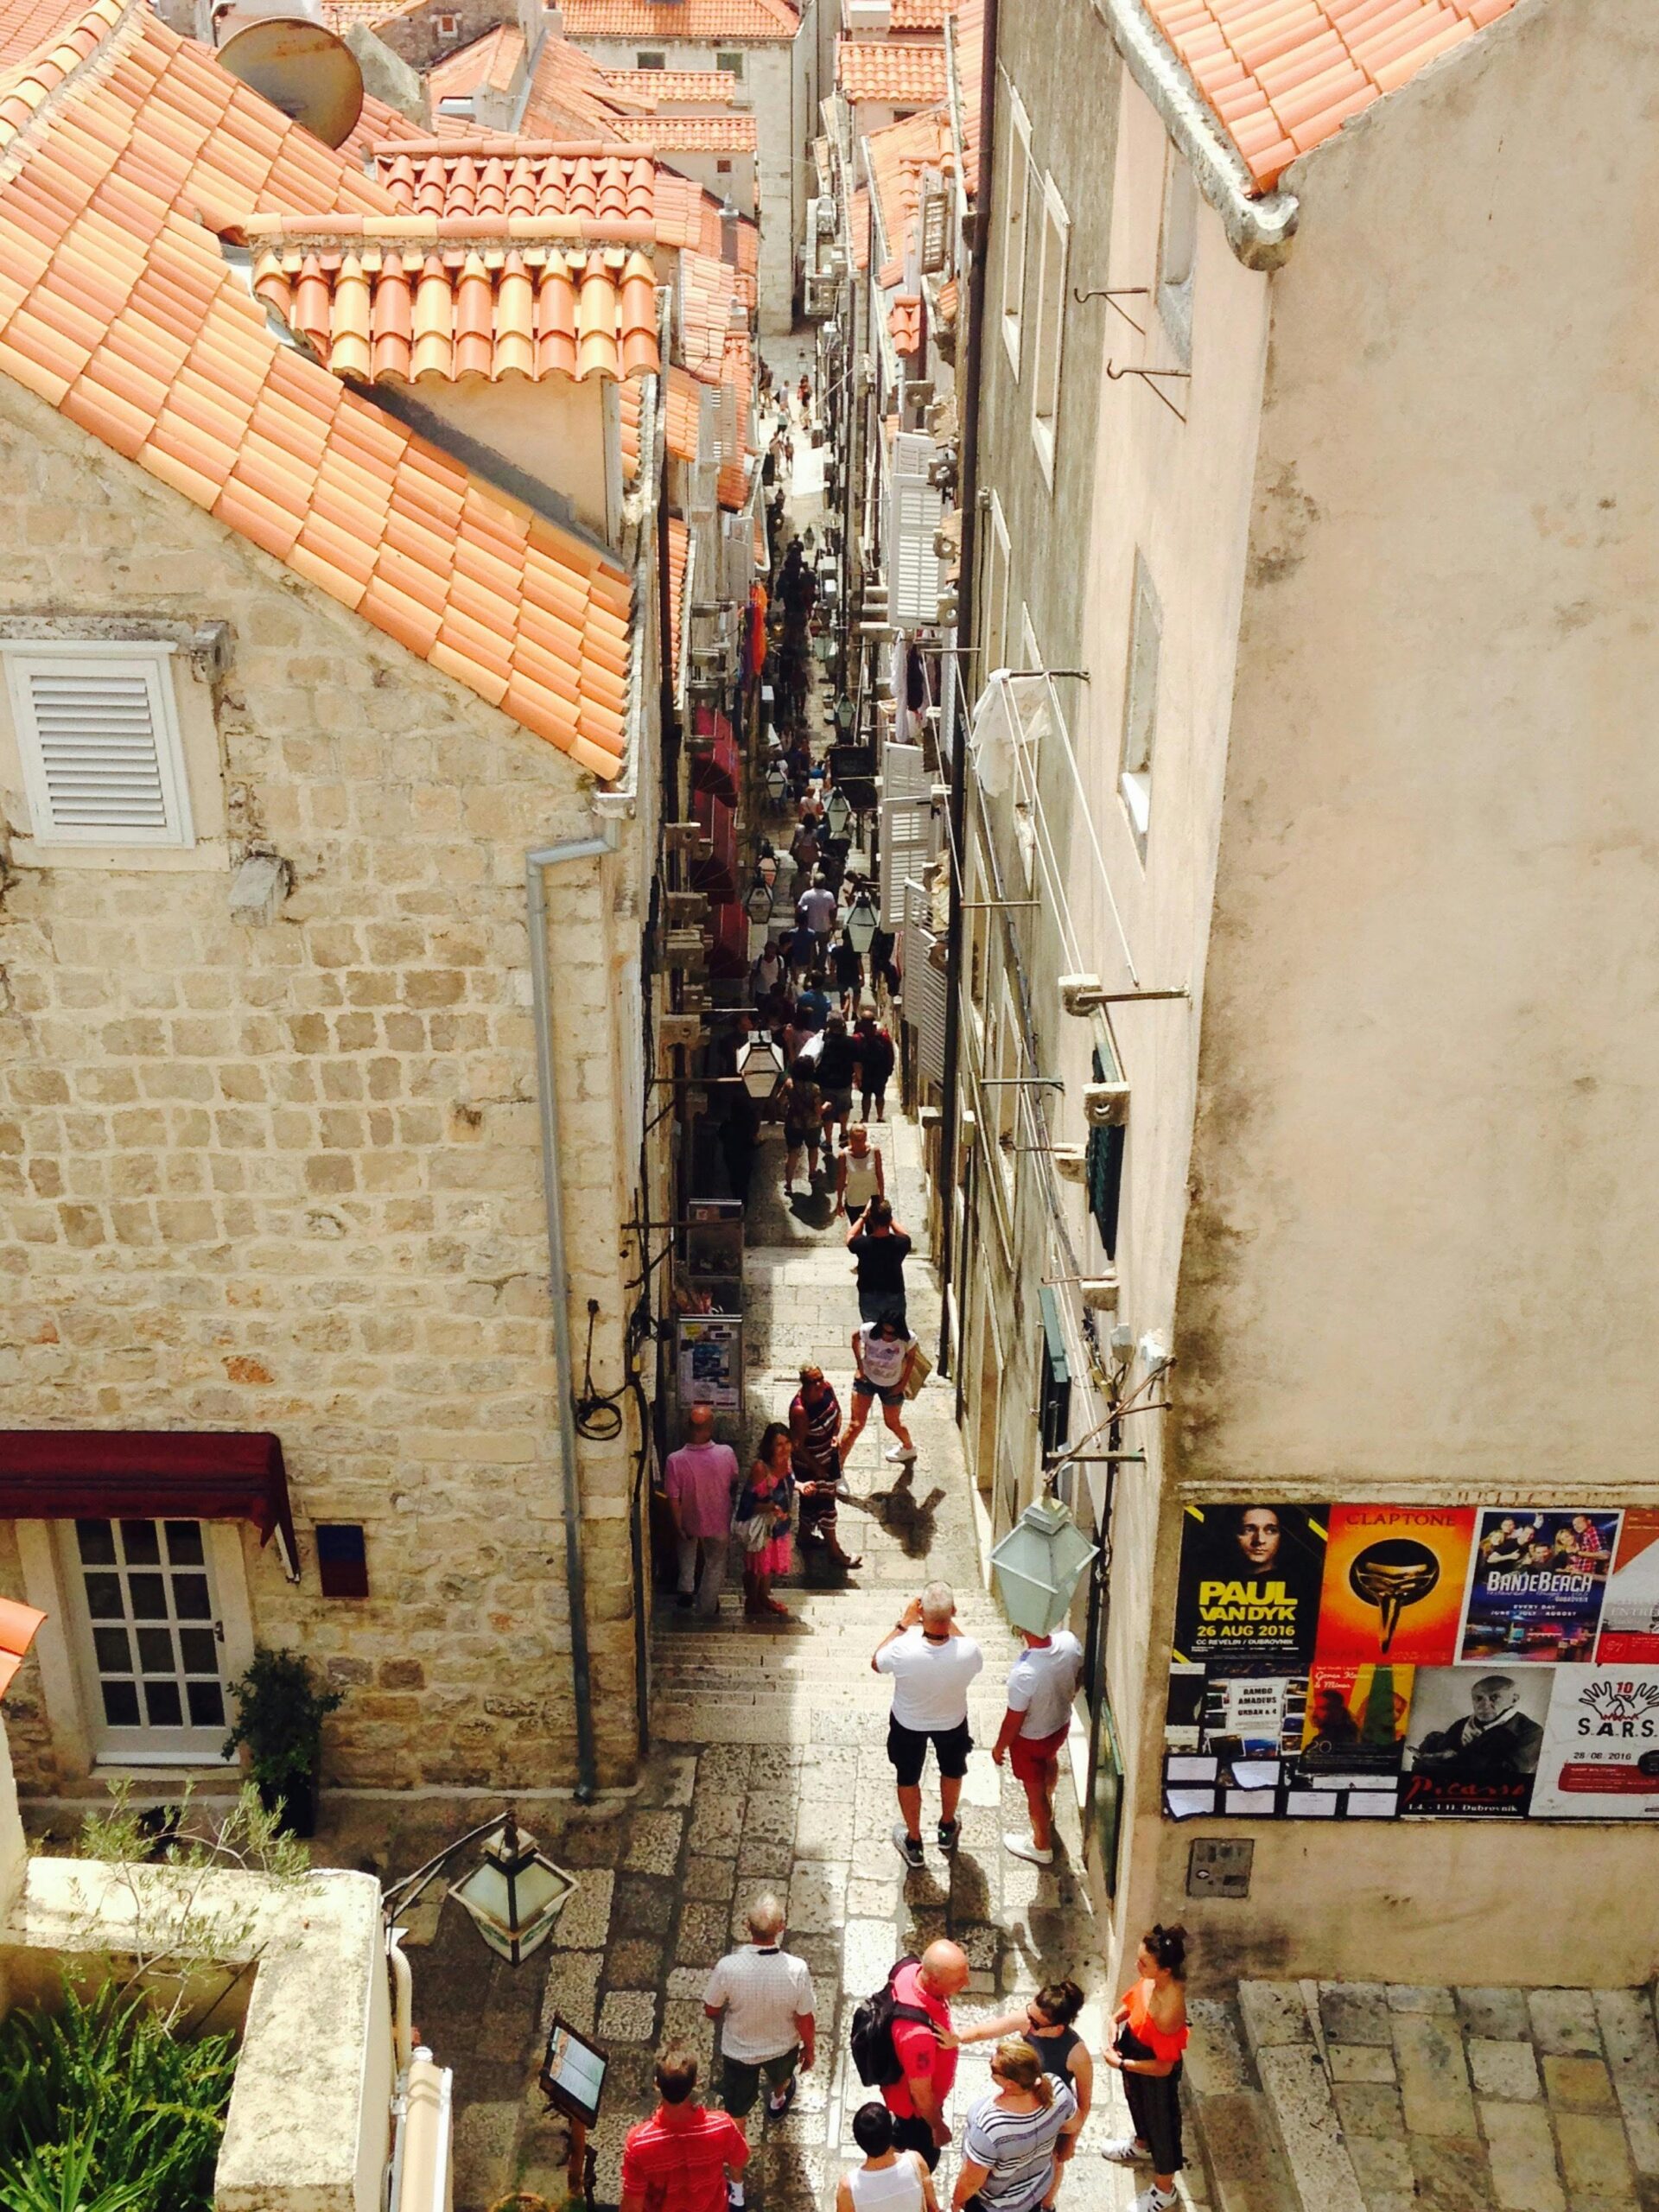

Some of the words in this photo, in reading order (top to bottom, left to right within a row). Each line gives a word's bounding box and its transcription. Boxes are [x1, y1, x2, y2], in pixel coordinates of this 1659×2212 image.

[1346, 1513, 1457, 1527] CLAPTONE
[1199, 1580, 1299, 1605] PAUL
[1199, 1606, 1246, 1621] VAN
[1248, 1606, 1297, 1621] DYK
[1197, 1625, 1217, 1637] 26
[1220, 1625, 1255, 1637] AUG
[1258, 1625, 1296, 1637] 2016
[1617, 1681, 1634, 1694] 10
[1238, 1696, 1277, 1705] AMADEUS
[1462, 1804, 1518, 1813] Dubrovnik
